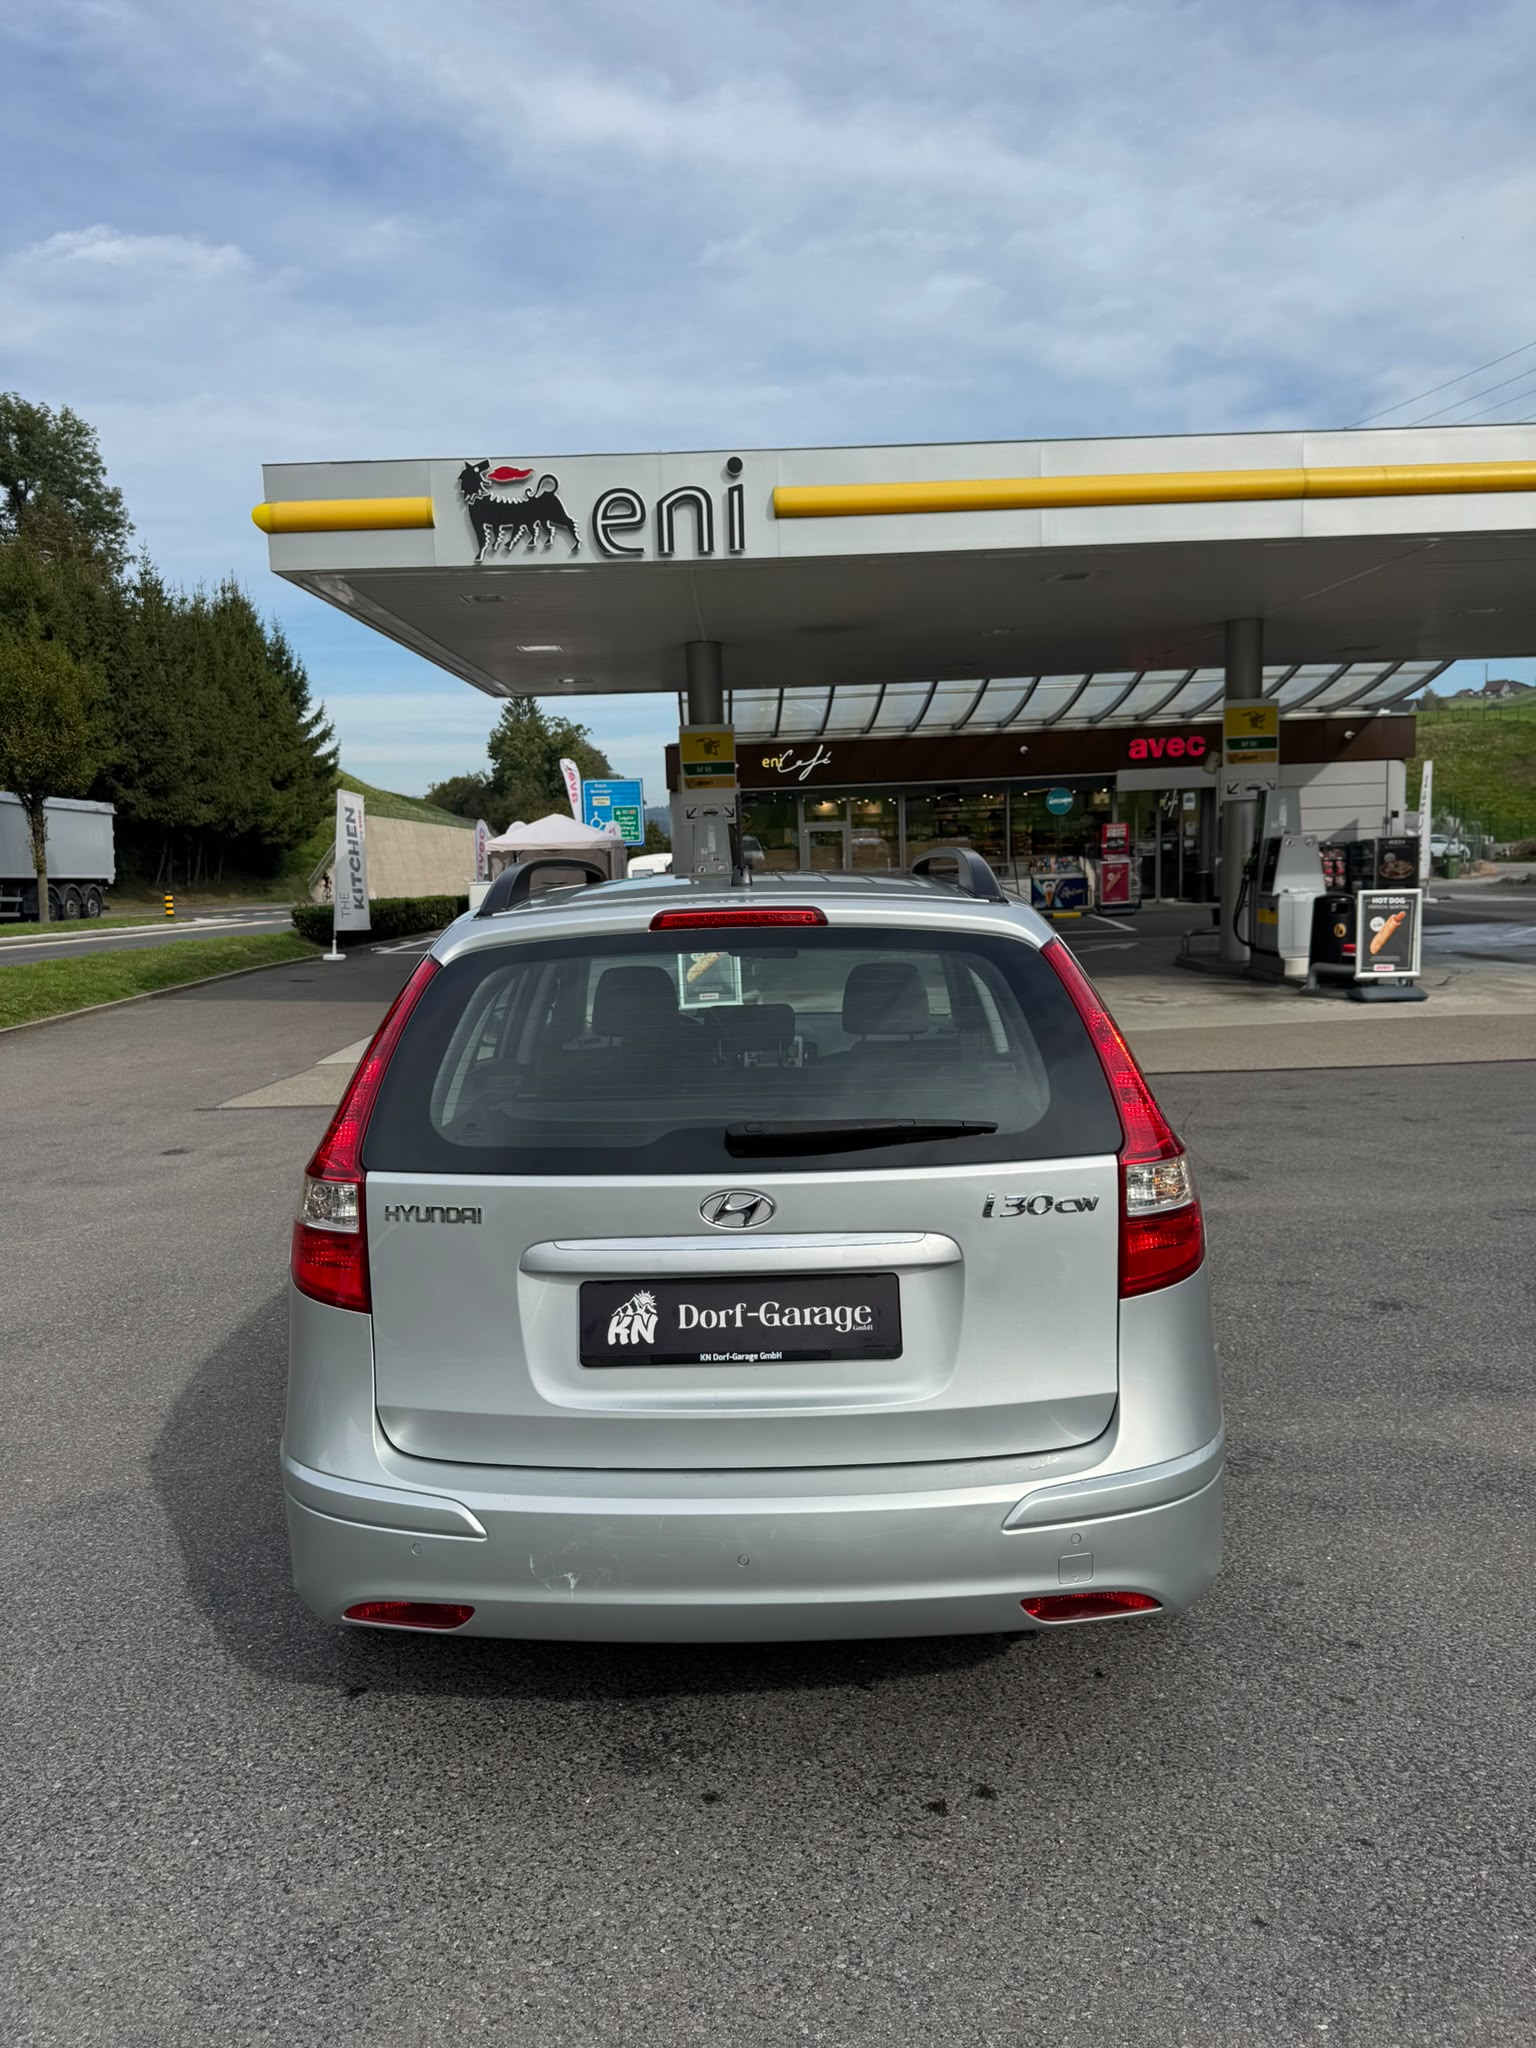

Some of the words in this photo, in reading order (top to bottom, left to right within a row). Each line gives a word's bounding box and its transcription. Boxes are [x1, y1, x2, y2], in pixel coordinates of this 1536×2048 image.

[592, 456, 745, 554] eni
[762, 754, 783, 768] eni
[777, 744, 832, 781] Café
[1128, 735, 1206, 759] avec
[344, 807, 365, 910] KITCHEN
[340, 891, 351, 919] THE
[385, 1204, 482, 1225] HYUNDAI
[607, 1313, 658, 1345] KN
[678, 1301, 872, 1333] Dorf-Garage
[700, 1353, 711, 1361] KN
[713, 1352, 758, 1362] Dorf-Garage
[760, 1351, 782, 1360] GmbH
